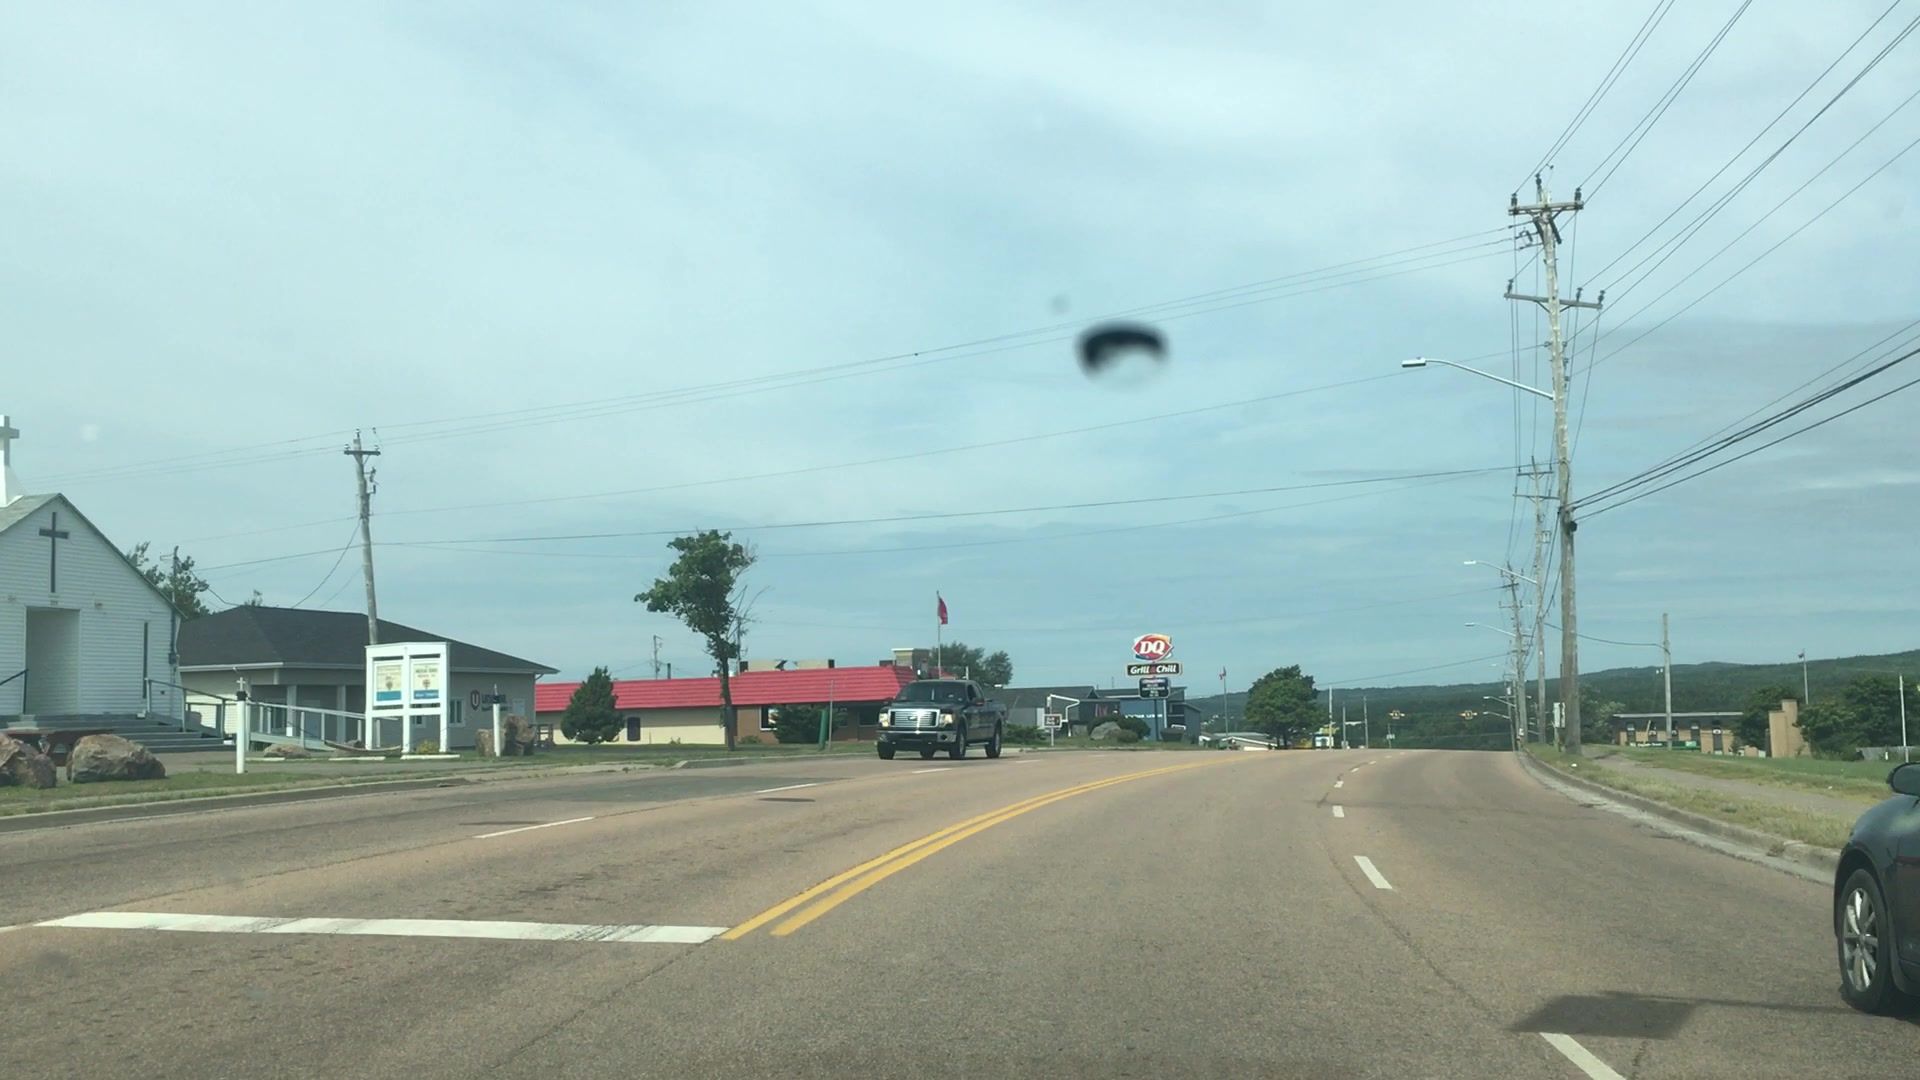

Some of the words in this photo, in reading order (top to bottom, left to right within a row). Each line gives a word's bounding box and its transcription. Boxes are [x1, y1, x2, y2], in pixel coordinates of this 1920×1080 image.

[1139, 640, 1166, 655] DQ
[1130, 665, 1150, 674] Grill
[1156, 664, 1177, 674] Chill
